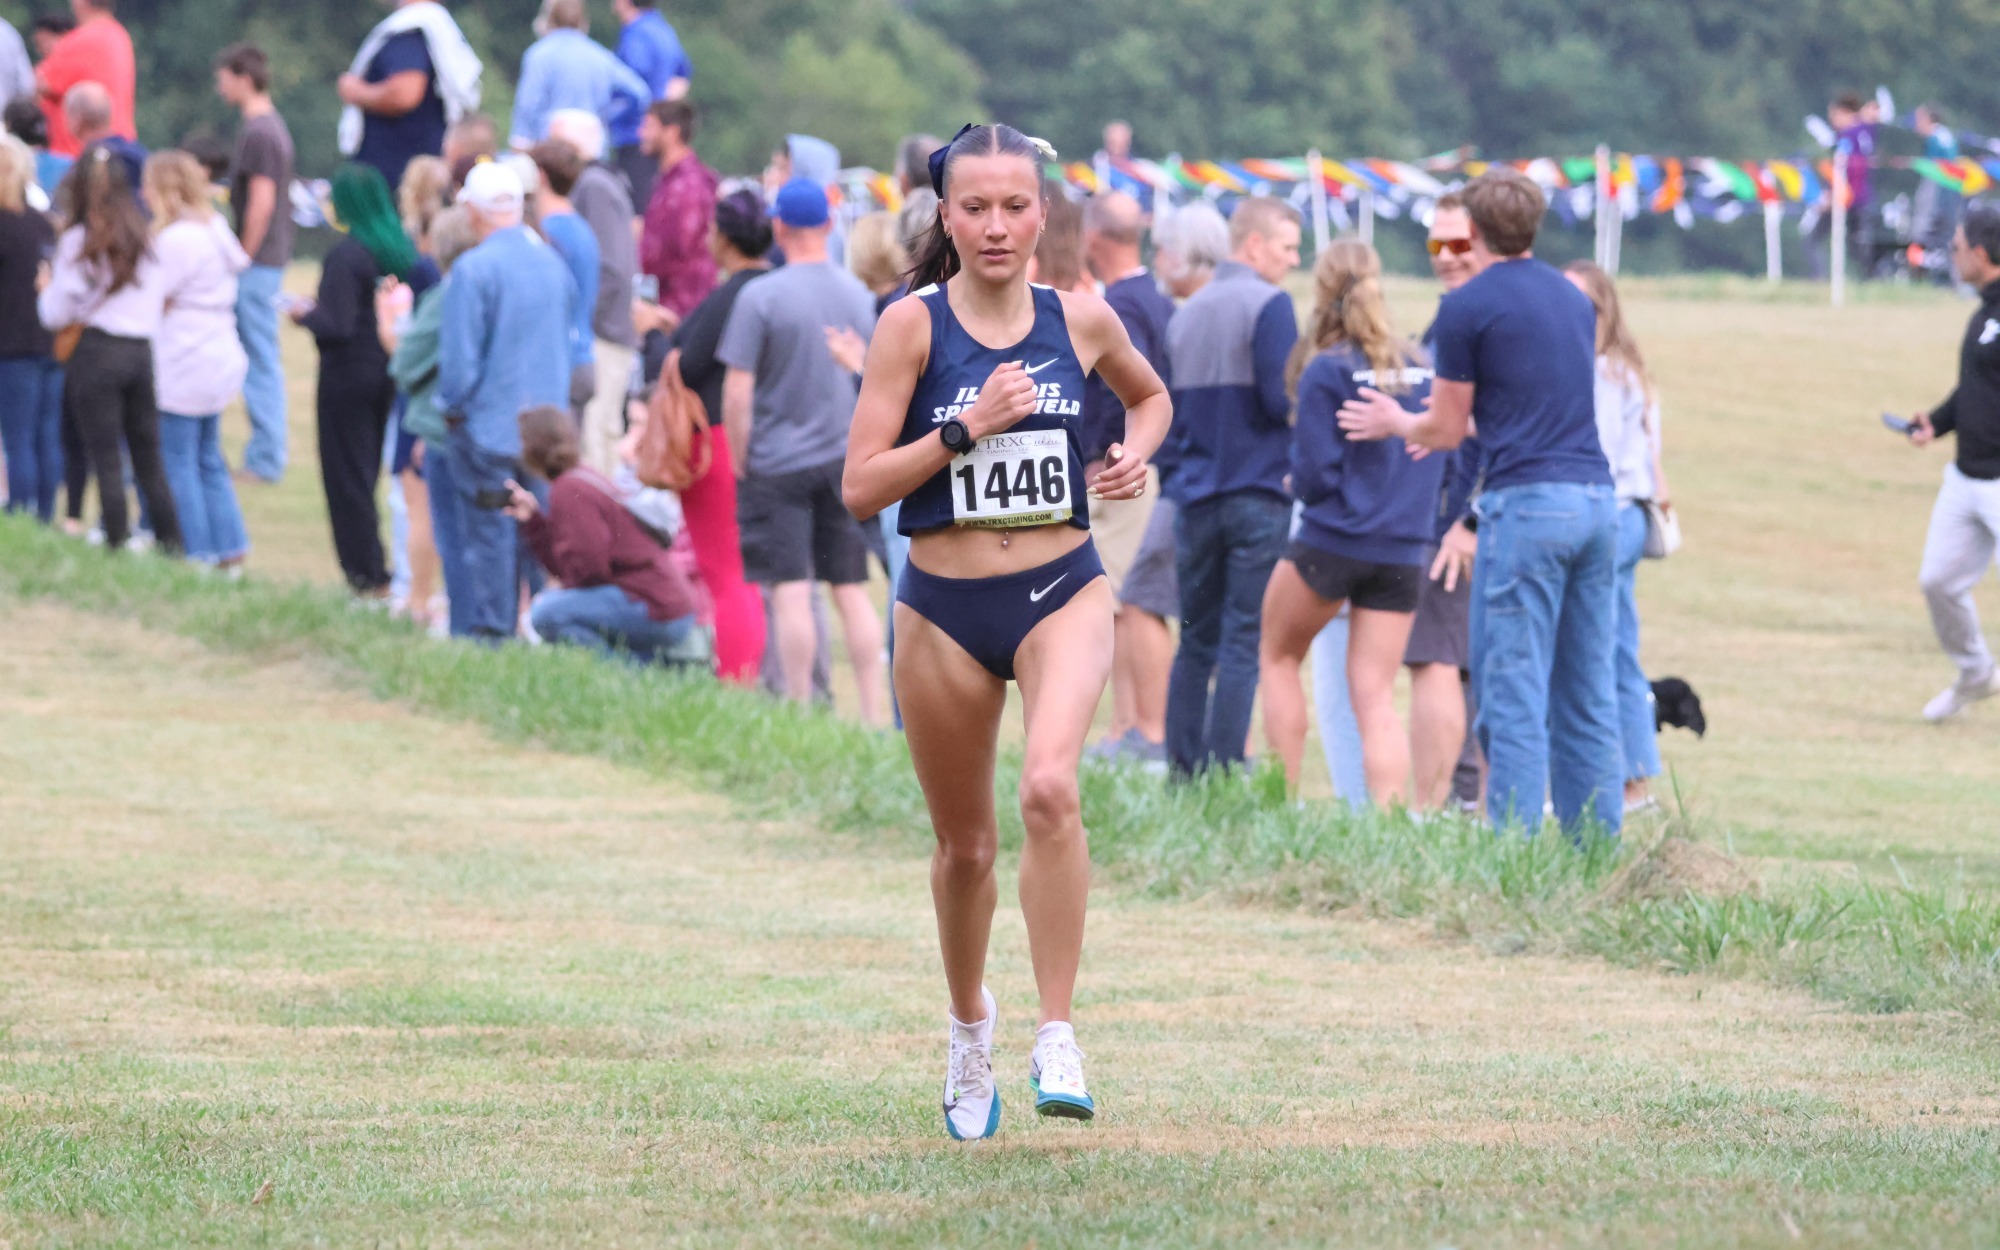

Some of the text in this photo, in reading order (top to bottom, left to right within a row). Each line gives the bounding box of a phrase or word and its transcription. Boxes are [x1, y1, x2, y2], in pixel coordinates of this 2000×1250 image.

[954, 383, 1062, 403] ILIS
[931, 399, 1081, 422] SPIELD
[983, 434, 1031, 450] TRXC
[956, 455, 1066, 511] 1446
[964, 513, 1052, 526] WWW.TRXCTIMING.COM
